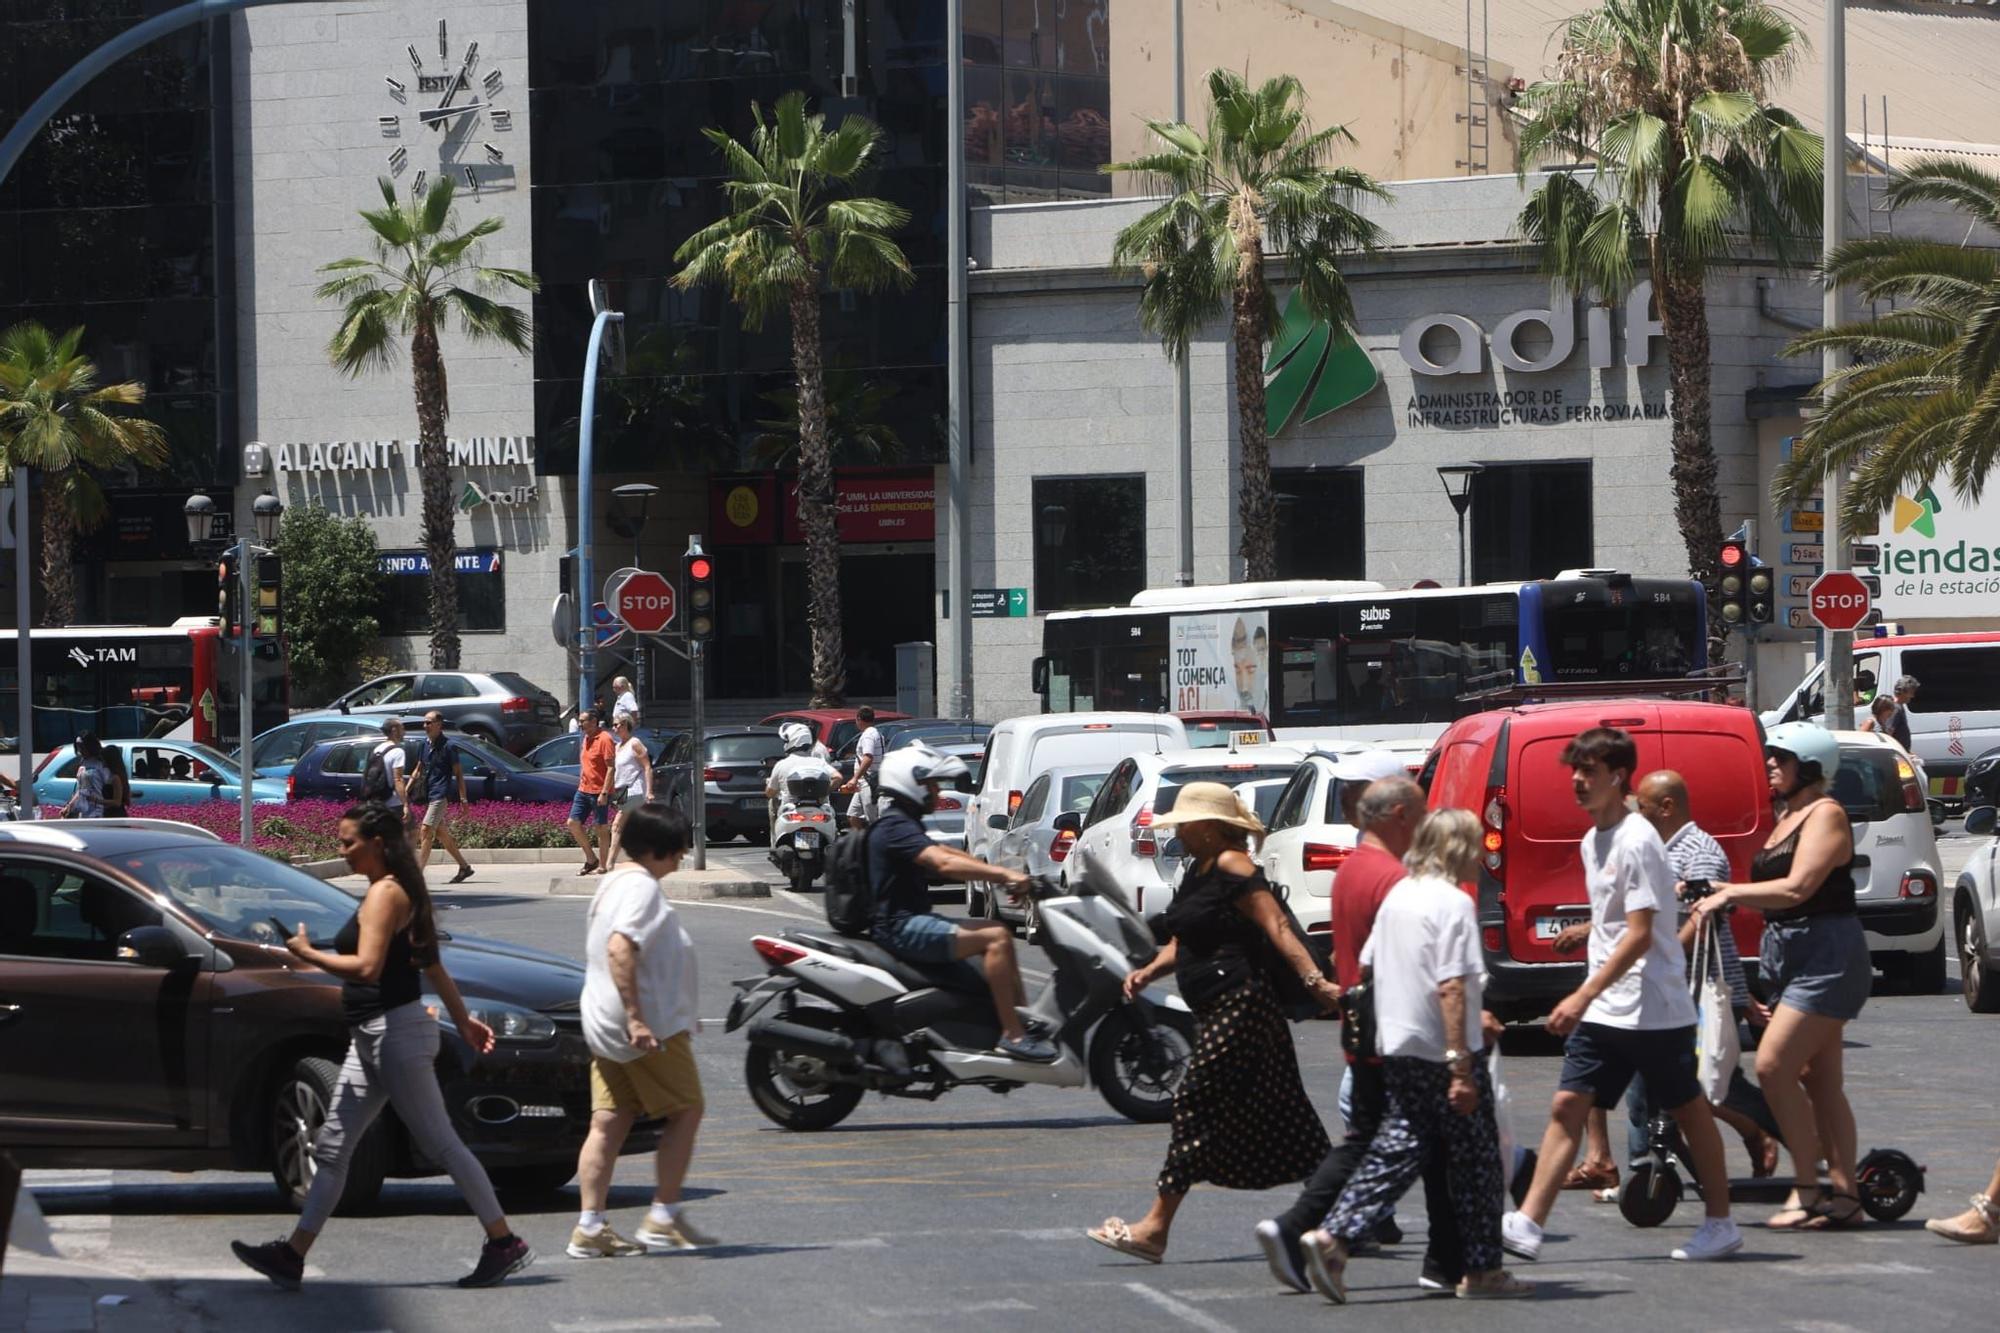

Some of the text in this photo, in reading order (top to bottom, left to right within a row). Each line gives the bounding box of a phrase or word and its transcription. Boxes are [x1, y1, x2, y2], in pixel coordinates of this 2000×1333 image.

[418, 75, 471, 91] FESTIA
[1400, 278, 1665, 375] adif
[1407, 389, 1563, 412] ADMINISTRADOR DE
[1408, 406, 1560, 429] INFRAESTRUCTURAS
[276, 436, 534, 471] ALACANT TMINAL
[869, 492, 881, 501] LA
[881, 490, 935, 500] UNIVERSIDAD
[1894, 580, 1915, 596] de
[1919, 579, 1933, 595] la
[623, 596, 671, 609] STOP
[1815, 594, 1865, 609] STOP
[1360, 605, 1391, 622] subus
[95, 647, 136, 662] TAM
[1177, 648, 1197, 666] TOT
[1177, 667, 1226, 689] COMENÇA
[1239, 732, 1259, 745] TAXI
